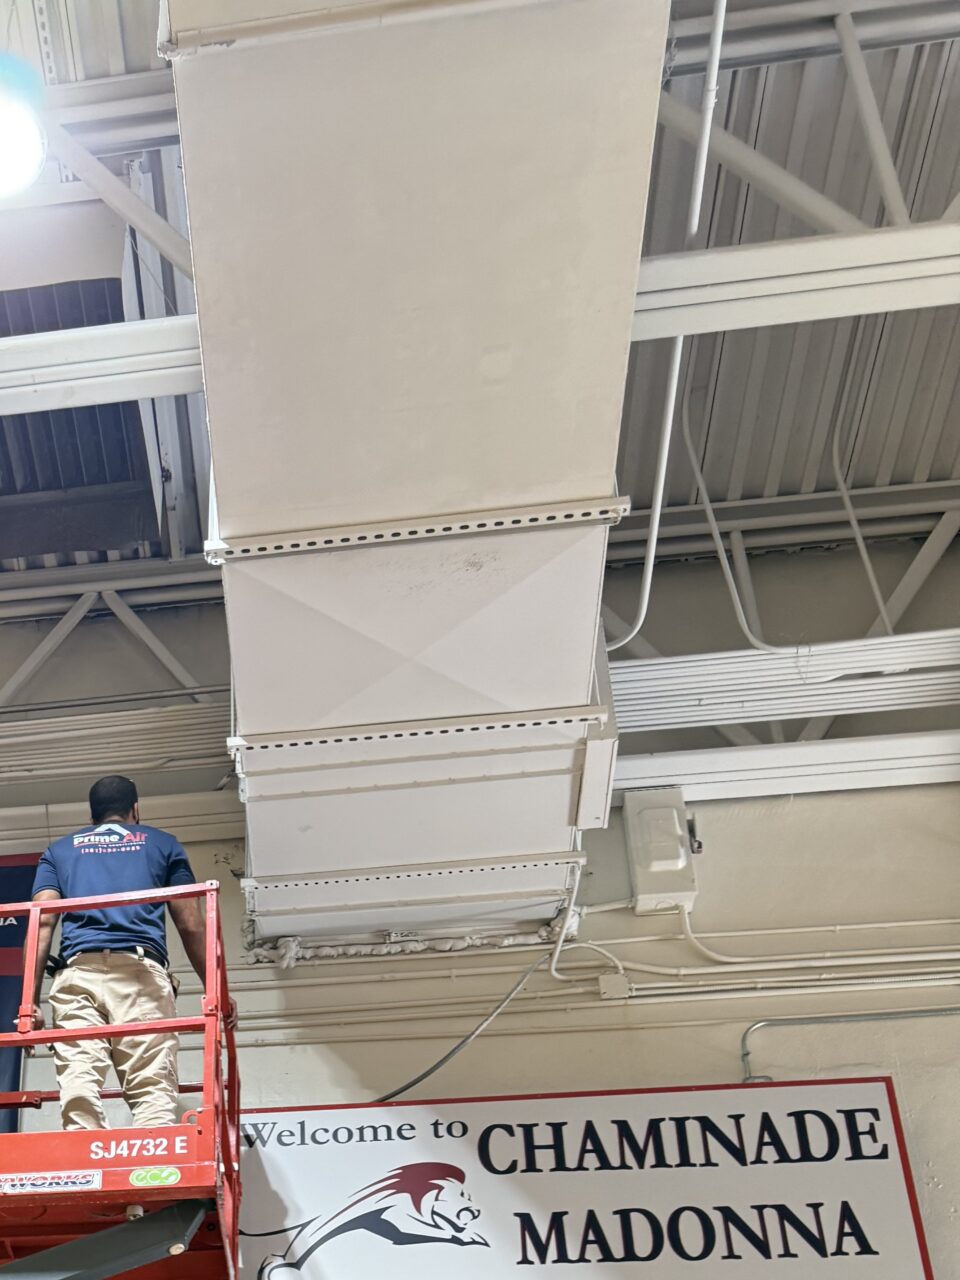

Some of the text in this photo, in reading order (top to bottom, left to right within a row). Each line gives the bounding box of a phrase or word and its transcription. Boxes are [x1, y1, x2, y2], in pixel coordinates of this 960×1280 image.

[73, 834, 120, 846] Prime
[123, 832, 148, 843] Air
[90, 1136, 188, 1160] SJ4732 E
[240, 1118, 469, 1149] Welcome to
[477, 1107, 889, 1175] CHAMINADE
[514, 1200, 879, 1265] MADONNA
